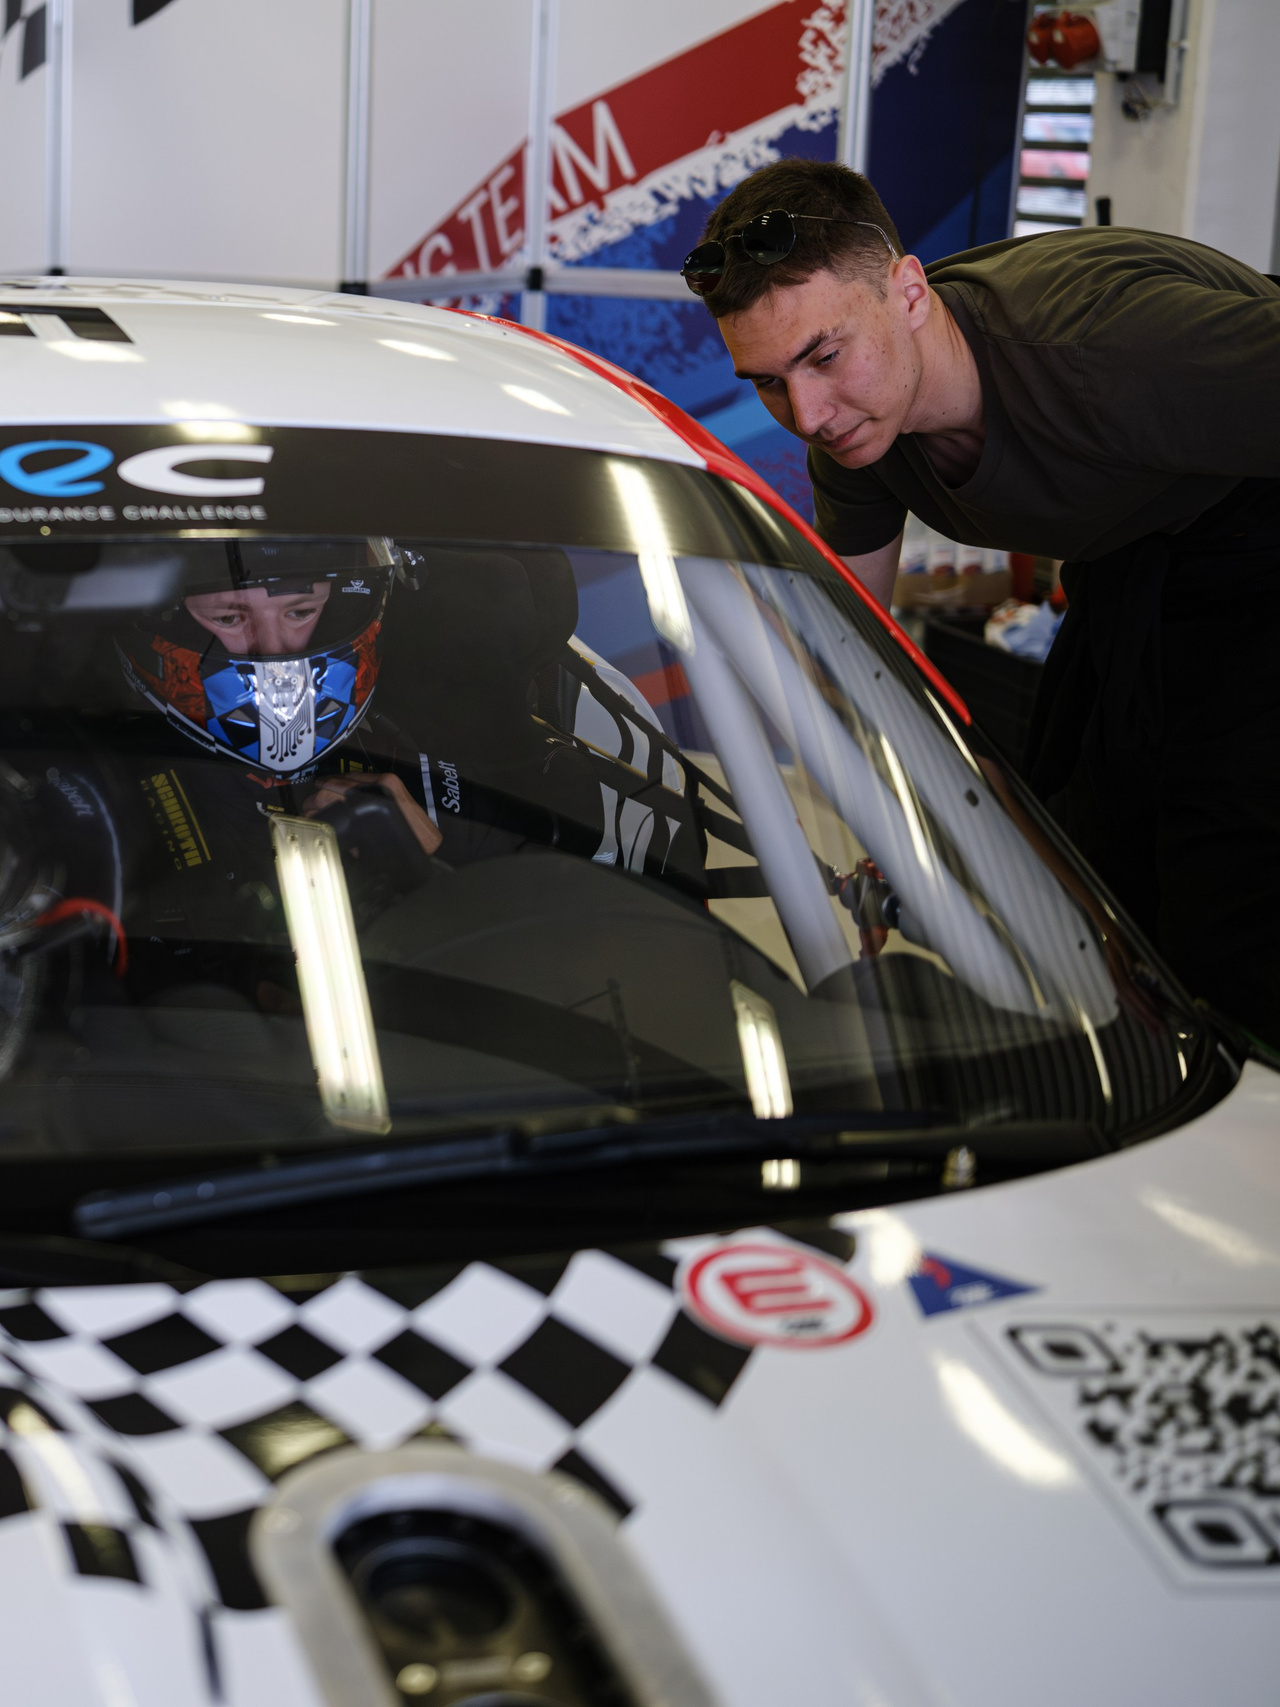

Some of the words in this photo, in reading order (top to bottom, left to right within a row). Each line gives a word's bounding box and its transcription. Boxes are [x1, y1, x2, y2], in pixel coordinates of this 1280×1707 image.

[122, 505, 268, 521] CHALLENGE
[437, 760, 461, 813] Sabelt
[151, 773, 202, 867] SCHROTH
